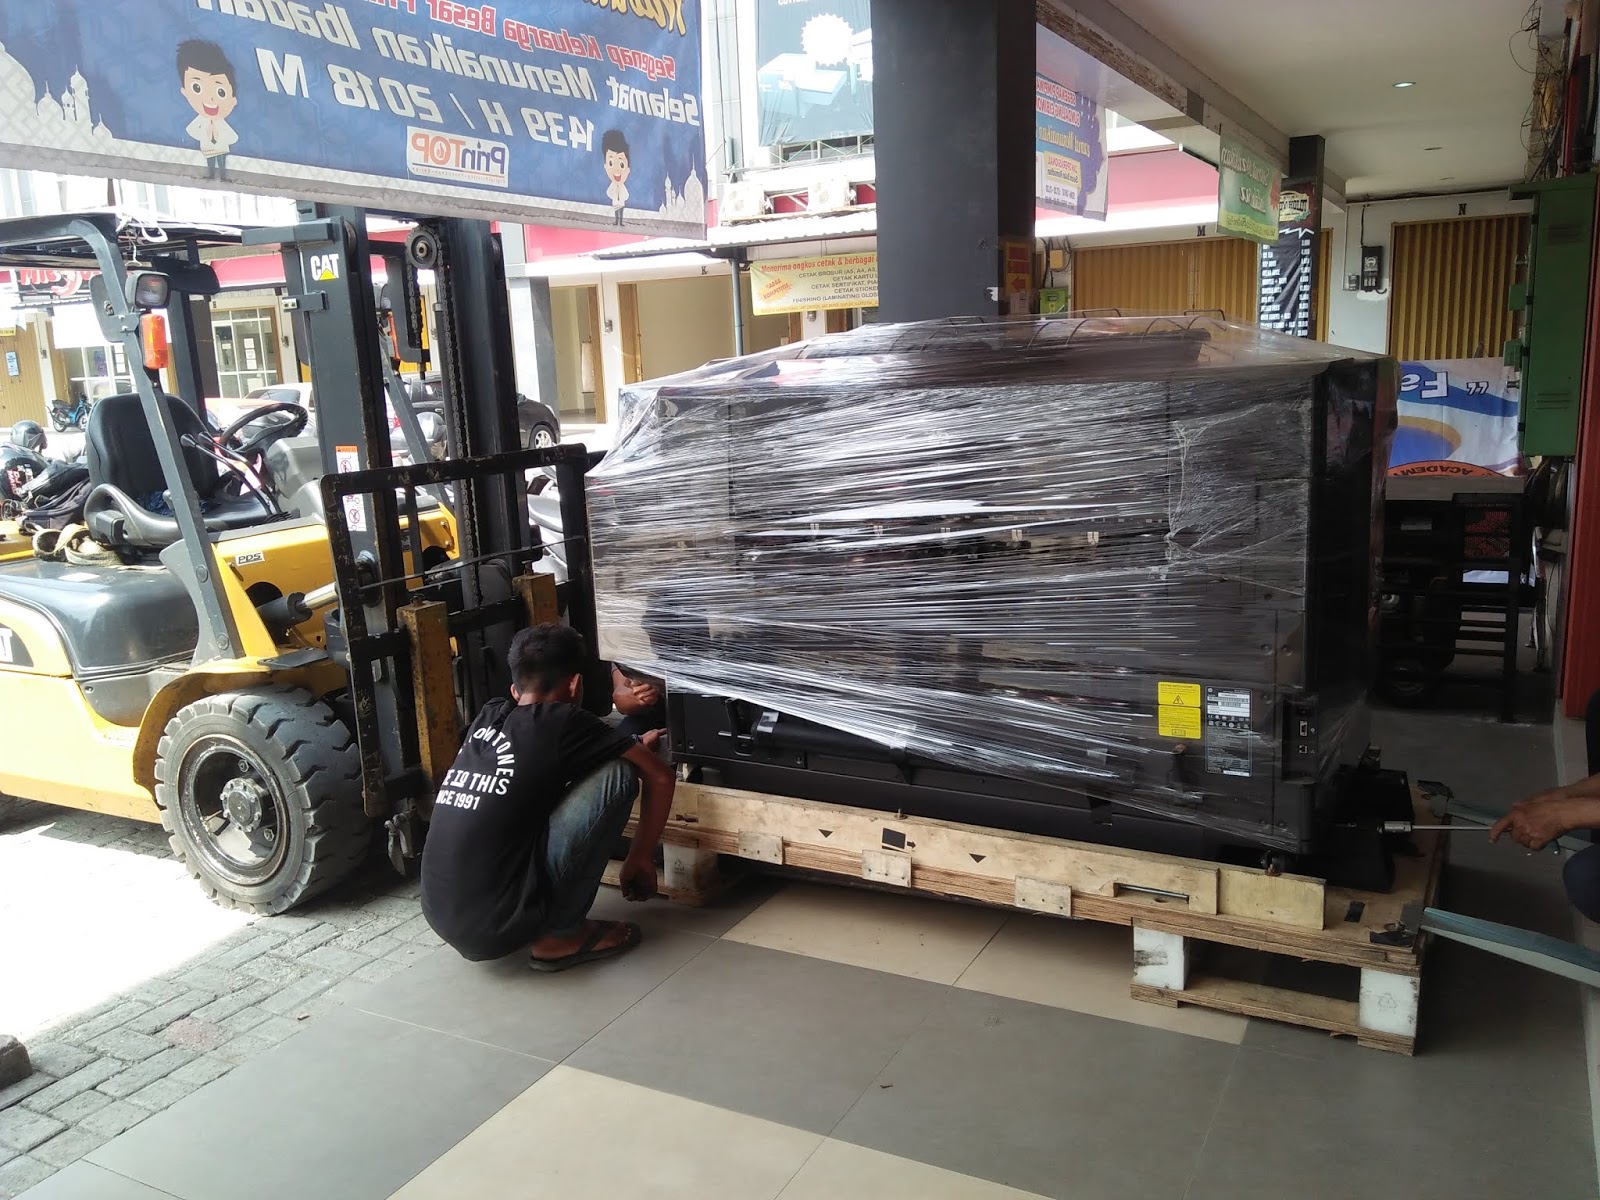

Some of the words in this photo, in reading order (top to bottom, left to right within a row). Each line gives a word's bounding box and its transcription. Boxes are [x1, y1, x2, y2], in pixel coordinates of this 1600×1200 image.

[1458, 203, 1467, 216] N
[1197, 225, 1206, 237] M
[310, 254, 340, 281] CAT
[701, 265, 709, 275] K
[760, 264, 791, 273] Menerima
[792, 260, 815, 271] ongkos
[817, 258, 835, 268] cetak
[837, 256, 843, 265] &
[844, 255, 875, 265] berbagai
[818, 269, 843, 277] BROSUR
[237, 552, 263, 564] PDS
[452, 769, 470, 787] TO
[468, 772, 510, 795] THIS
[454, 792, 480, 810] 1991
